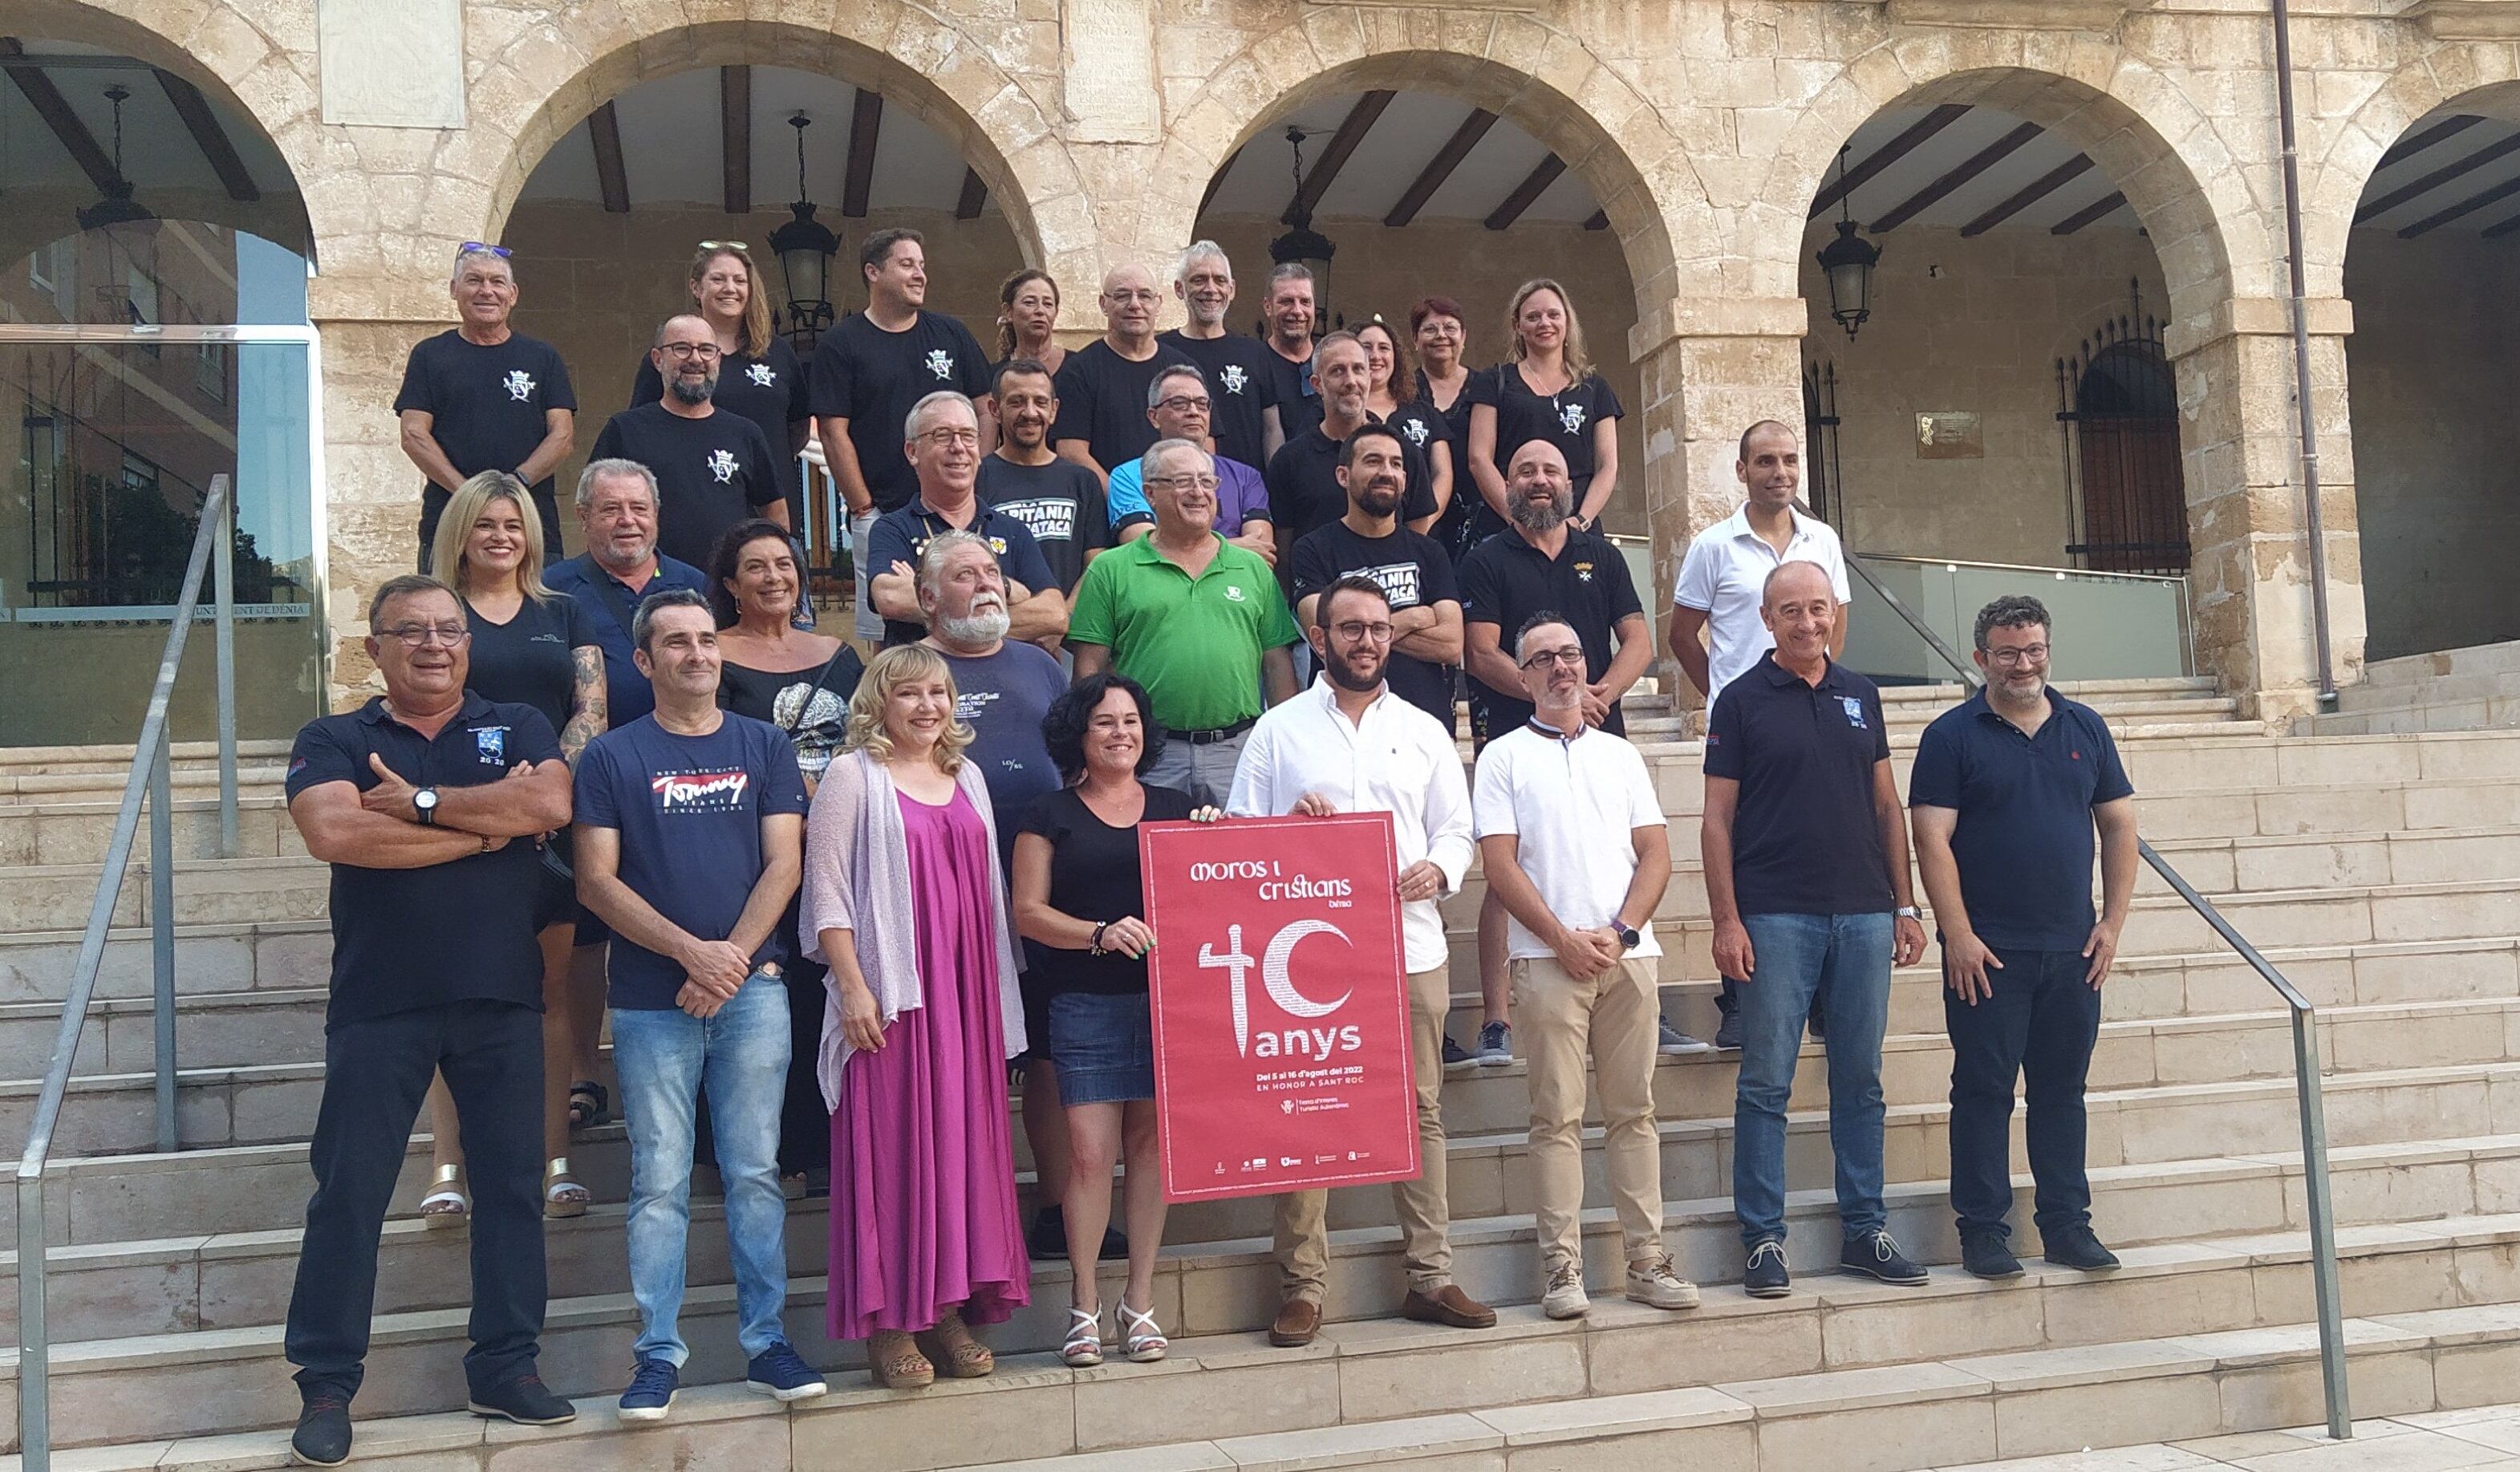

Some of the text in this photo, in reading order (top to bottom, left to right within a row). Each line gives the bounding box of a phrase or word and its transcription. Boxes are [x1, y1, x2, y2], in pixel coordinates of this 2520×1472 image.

[652, 773, 747, 807] Tommy
[1255, 1024, 1361, 1061] anys
[1256, 1073, 1271, 1082] Del
[1272, 1073, 1278, 1081] 5
[1279, 1072, 1287, 1080] al
[1288, 1071, 1297, 1079] 16
[1329, 1068, 1343, 1076] del
[1343, 1065, 1364, 1074] 2022
[1256, 1076, 1364, 1092] EN HONOR A SANT ROC
